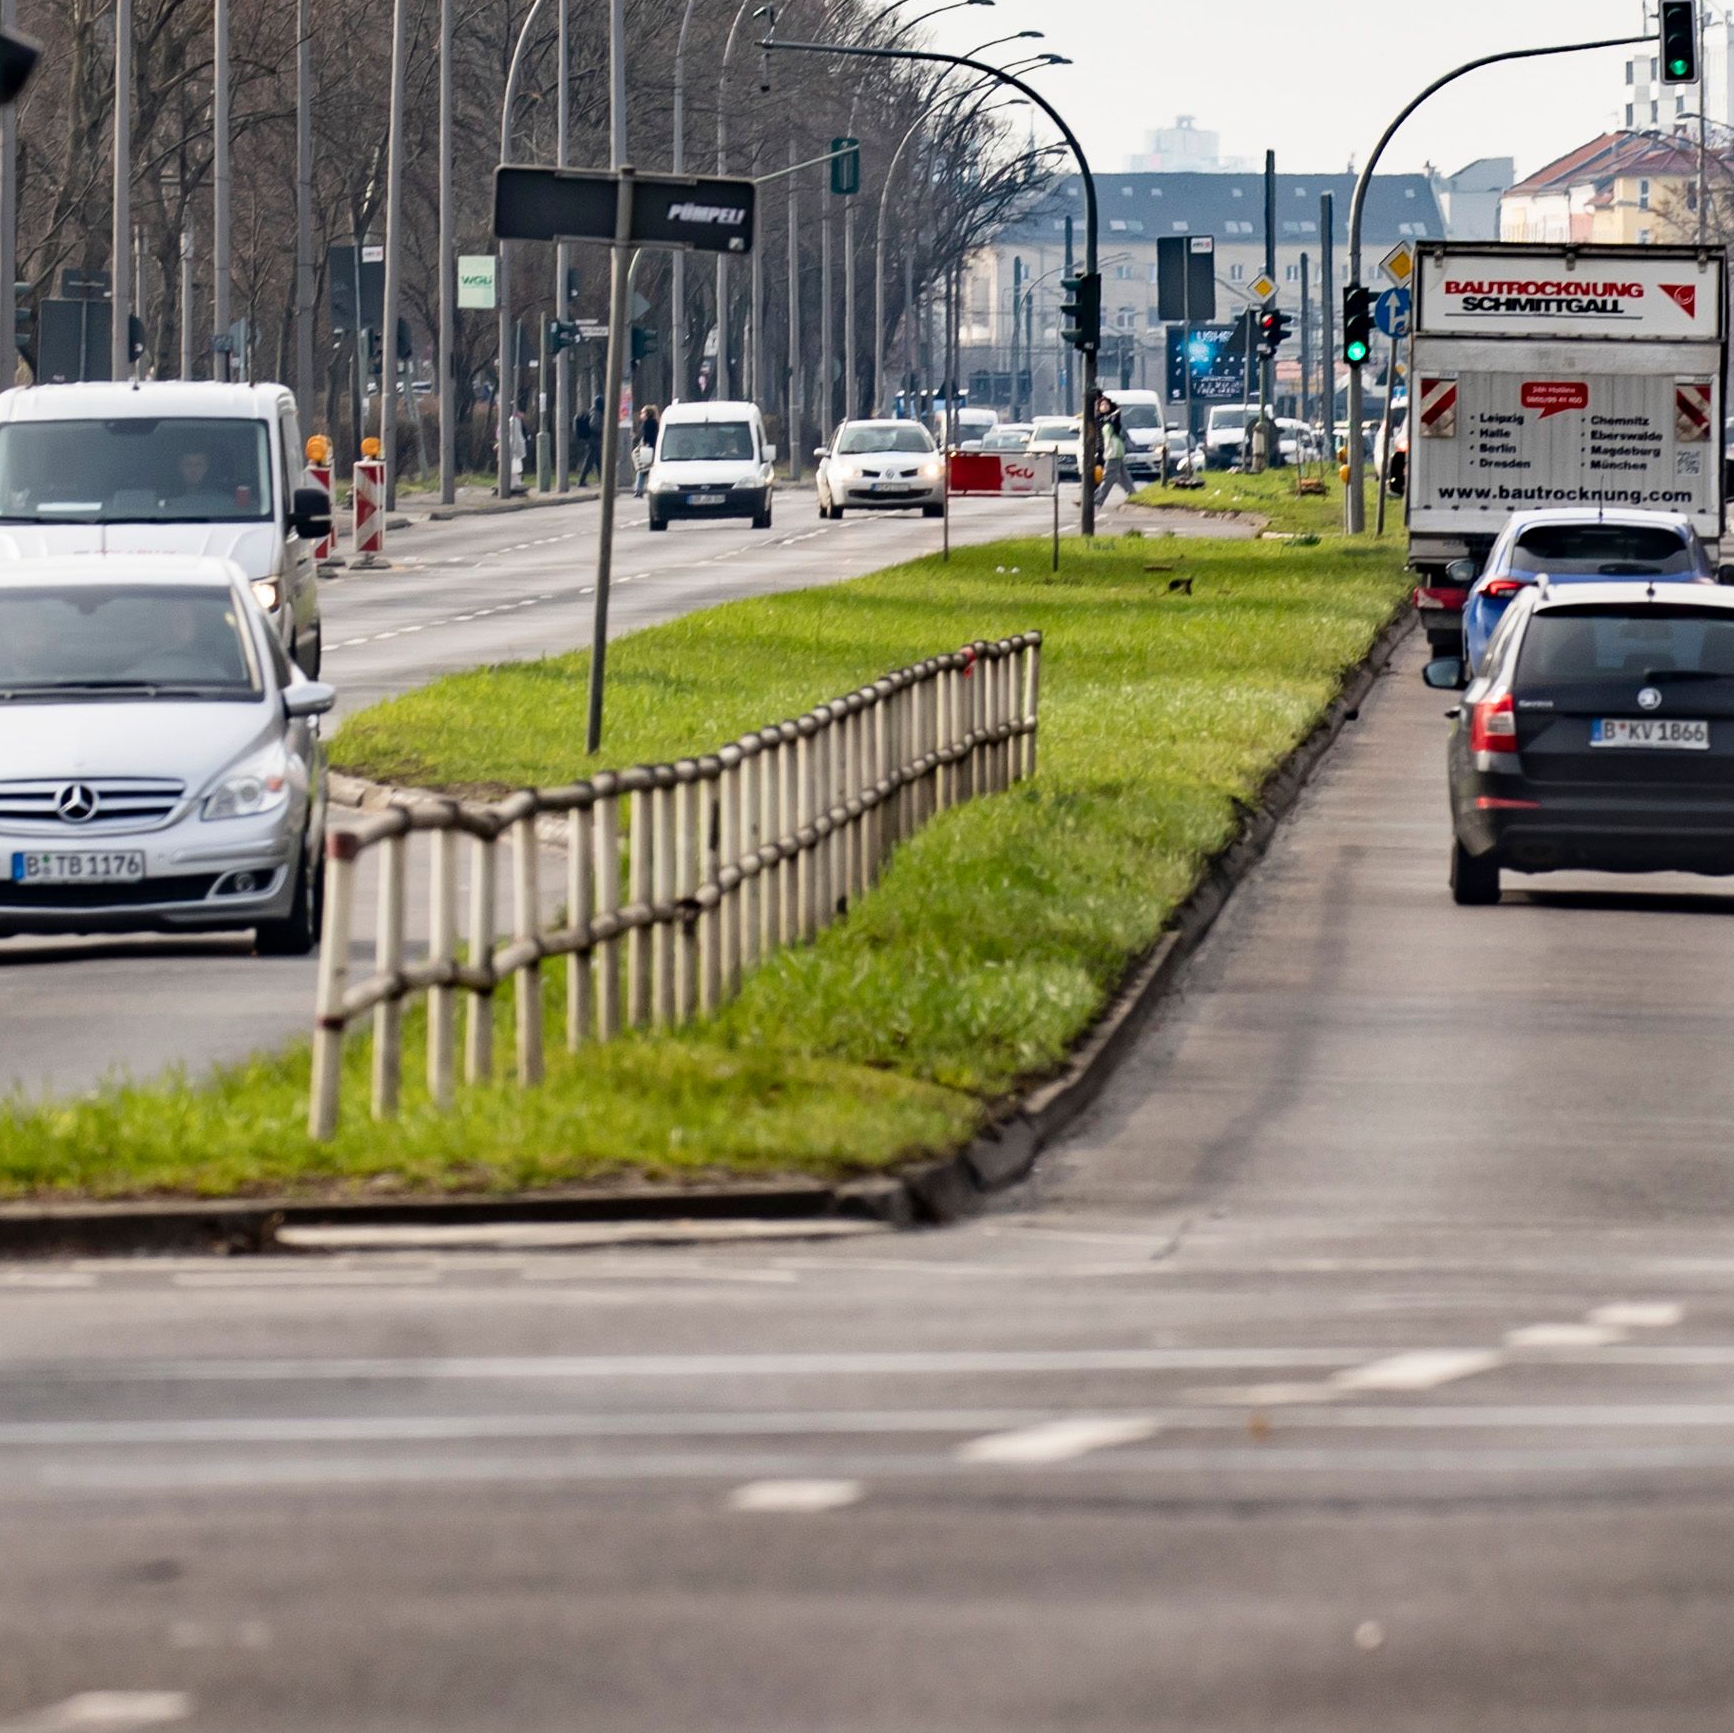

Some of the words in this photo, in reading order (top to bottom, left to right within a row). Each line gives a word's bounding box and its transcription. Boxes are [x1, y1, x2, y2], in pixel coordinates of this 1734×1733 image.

[1445, 280, 1644, 298] BAUTROCKNUNG
[1462, 296, 1625, 314] SCHMITTGALL
[1479, 413, 1525, 425] Leipzig
[1590, 415, 1650, 426] Chemnitz
[1479, 428, 1511, 439] Halle
[1590, 430, 1663, 443] Eberswalde
[1479, 443, 1517, 454] Berlin
[1590, 445, 1662, 458] Magdeburg
[1479, 458, 1532, 469] Dresden
[1590, 459, 1648, 471] München
[1438, 485, 1693, 505] www.bautrocknung.com
[1603, 721, 1617, 740] B
[1628, 722, 1655, 741] KV
[1658, 722, 1706, 742] 1866
[26, 856, 40, 876] B
[55, 856, 82, 876] TB
[87, 854, 142, 875] 1176
